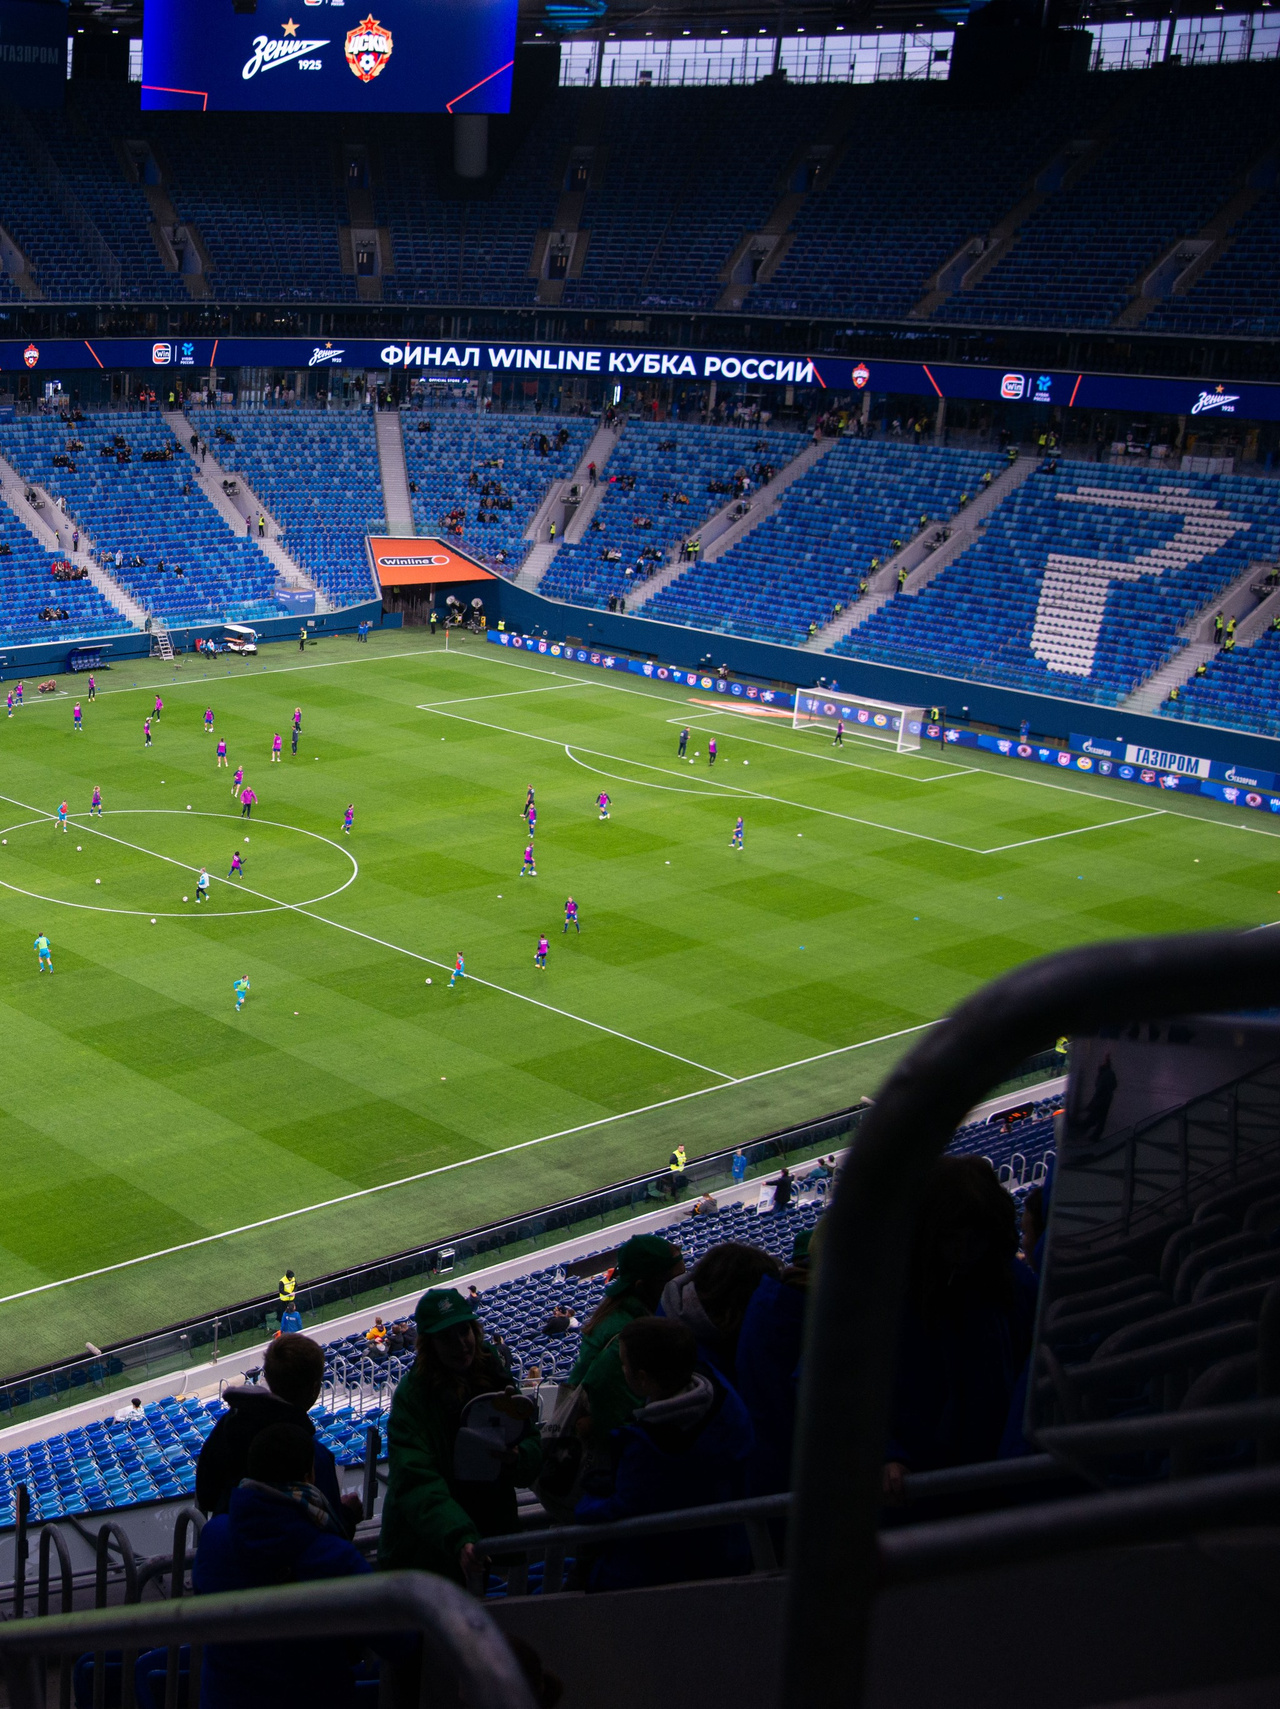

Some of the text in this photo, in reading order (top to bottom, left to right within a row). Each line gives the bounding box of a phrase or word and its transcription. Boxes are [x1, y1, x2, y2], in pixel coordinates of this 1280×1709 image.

[3, 44, 59, 64] ГАЗПРОМ
[348, 34, 389, 54] ЦСКА
[242, 35, 331, 80] Зенит
[298, 60, 322, 71] 1925
[381, 345, 813, 383] ФИНАЛ WINLINE КУБКА РОССИИ
[1135, 748, 1200, 774] ГАЗПРОМ
